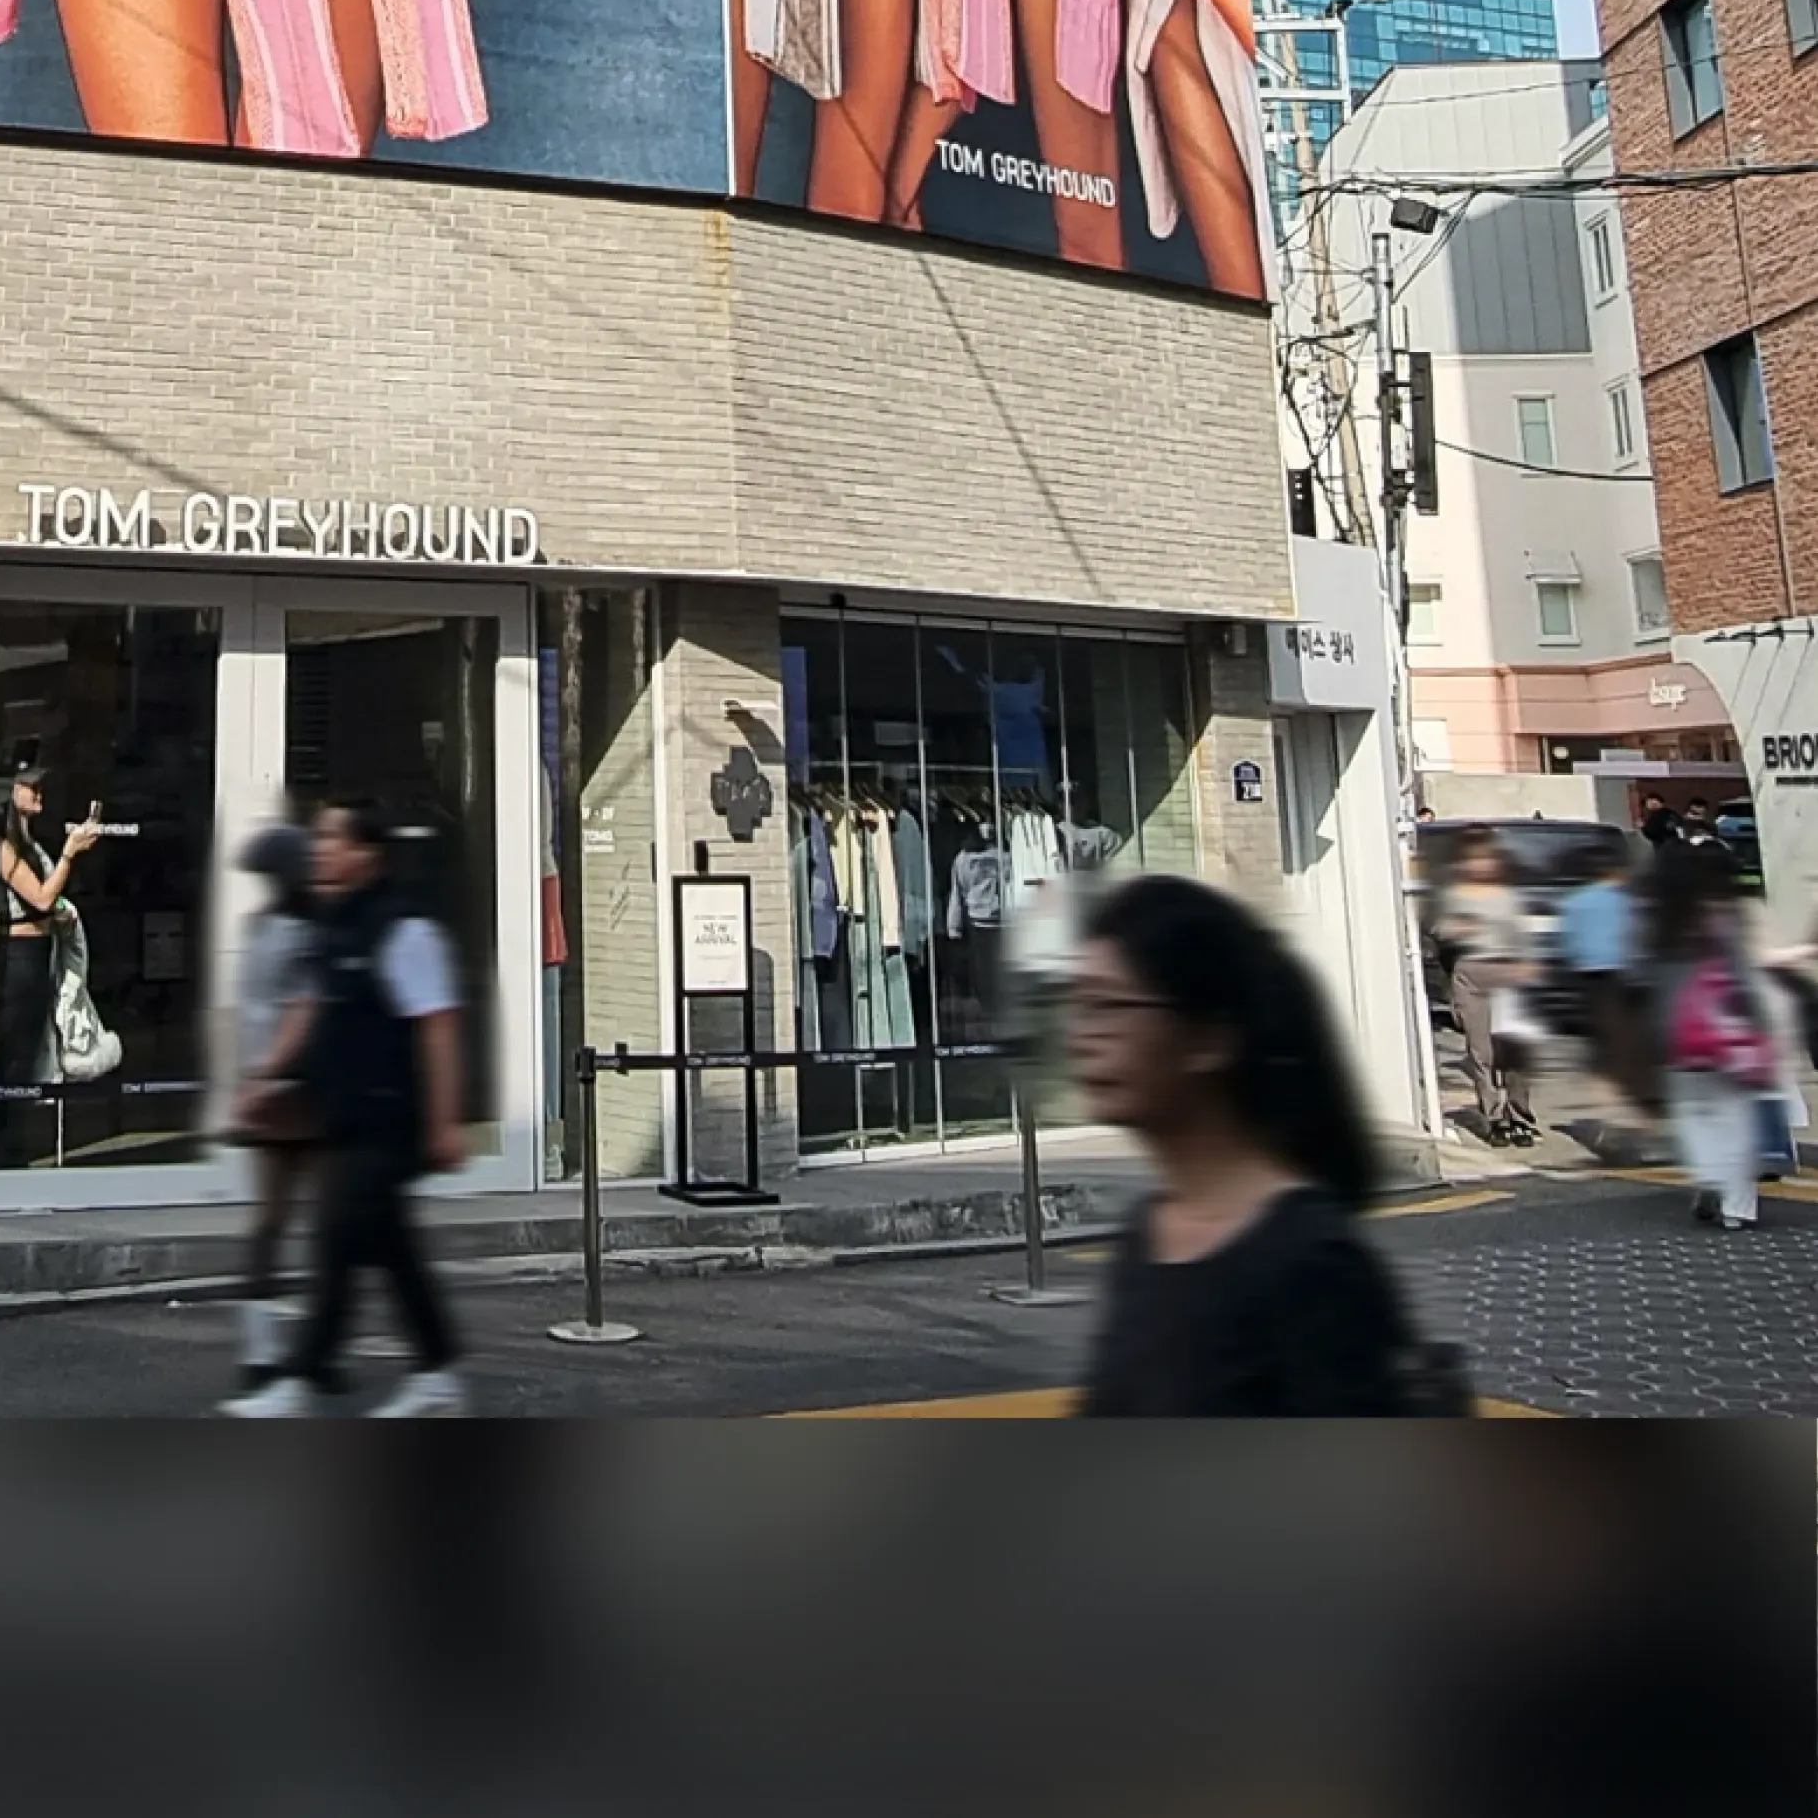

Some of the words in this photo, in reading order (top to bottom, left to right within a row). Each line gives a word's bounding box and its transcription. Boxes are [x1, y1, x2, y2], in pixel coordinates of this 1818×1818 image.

[935, 138, 985, 179] TOM
[991, 151, 1116, 208] GREYHOUND
[17, 483, 151, 547] TOM
[182, 492, 540, 565] GREYHOUND
[1762, 733, 1818, 770] BRIO
